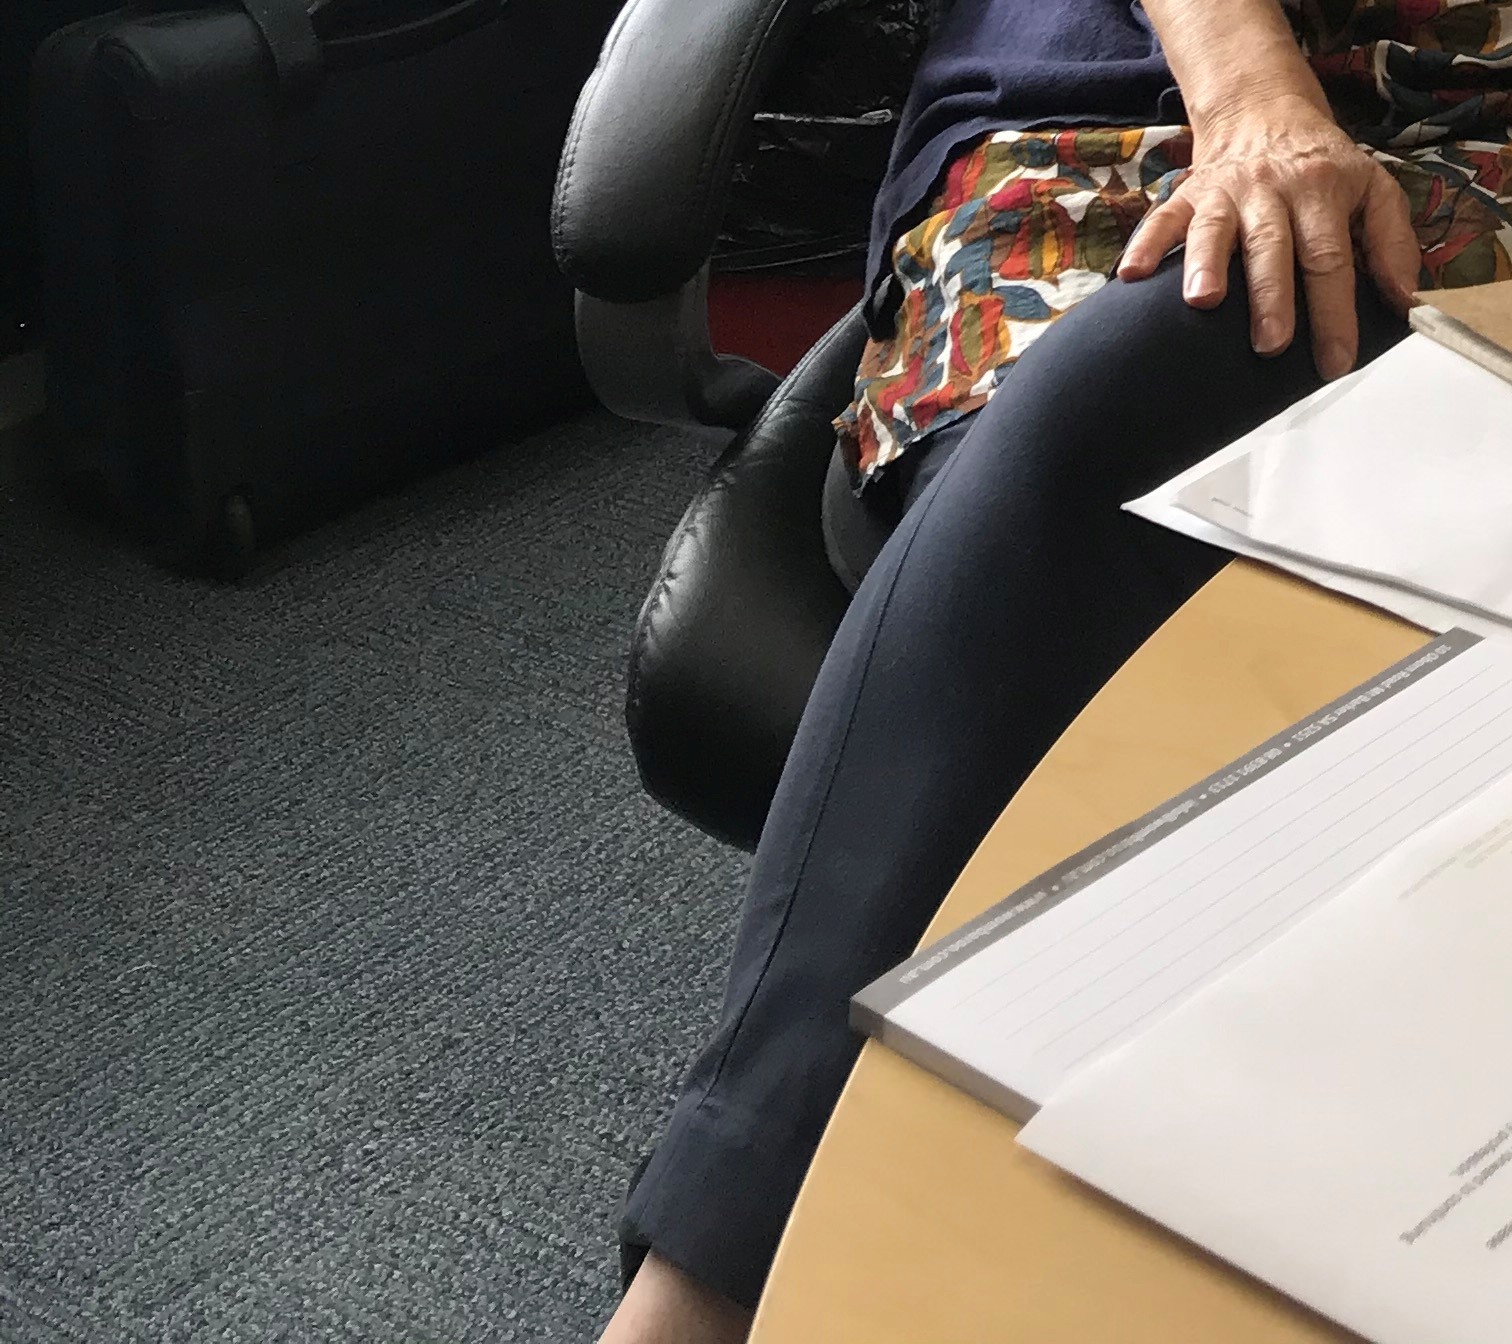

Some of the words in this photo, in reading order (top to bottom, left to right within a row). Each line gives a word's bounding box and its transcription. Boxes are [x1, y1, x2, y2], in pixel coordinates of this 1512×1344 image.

[1381, 667, 1410, 689] Road
[1333, 692, 1369, 717] Barker
[1317, 712, 1336, 727] SA
[1291, 721, 1321, 743] 5251
